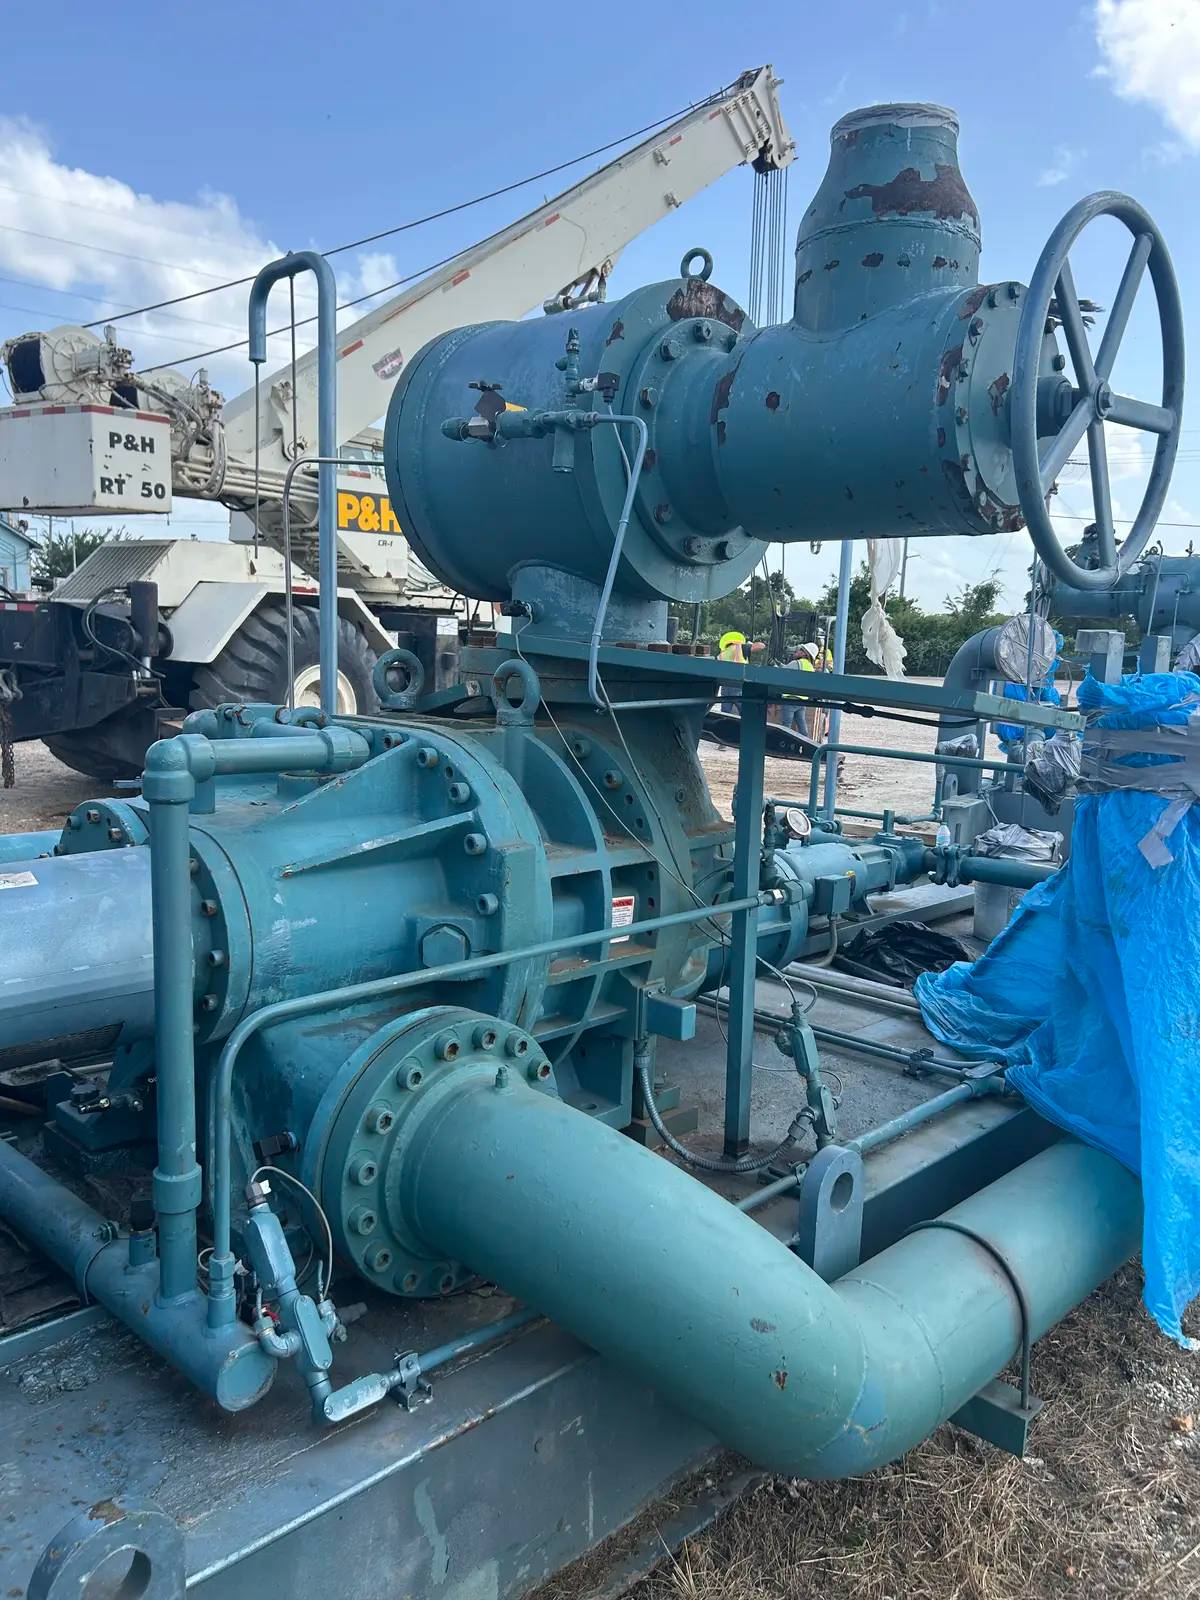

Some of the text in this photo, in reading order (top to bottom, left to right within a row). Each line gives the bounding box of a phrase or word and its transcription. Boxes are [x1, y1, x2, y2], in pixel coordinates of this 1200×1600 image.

[109, 431, 155, 454] P&H
[100, 476, 166, 500] RT 50
[337, 492, 402, 533] P&H
